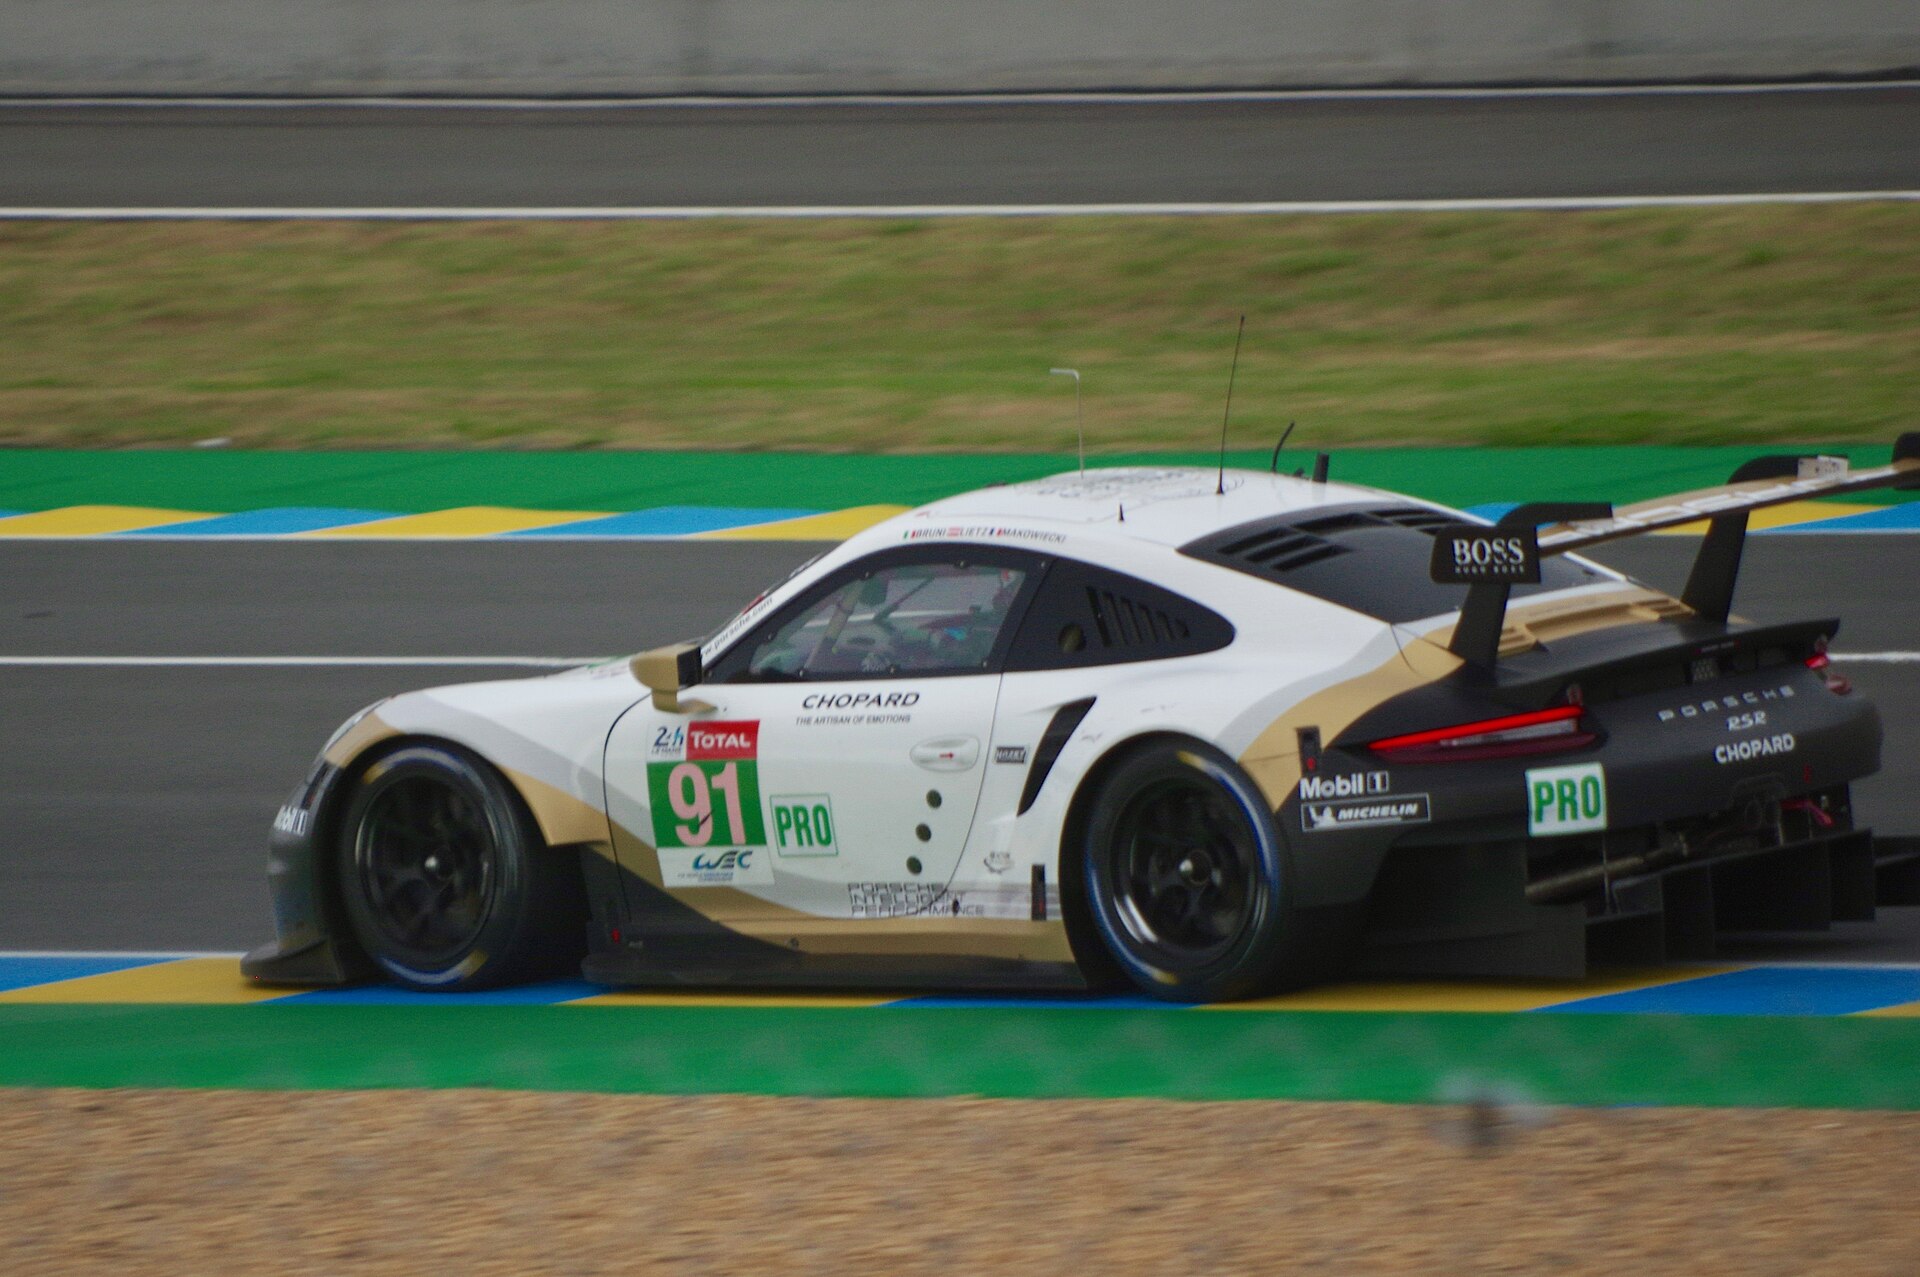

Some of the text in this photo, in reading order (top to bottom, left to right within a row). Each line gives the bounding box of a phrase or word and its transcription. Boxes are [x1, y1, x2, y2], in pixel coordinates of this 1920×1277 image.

[916, 527, 1067, 544] BRUNI LIETZ MAKOWIECKI
[1452, 538, 1524, 565] BOSS
[802, 691, 920, 709] CHOPARD
[796, 714, 911, 726] THE ARTISAN OF EMOTIONS
[1727, 710, 1767, 731] RSR
[690, 731, 751, 749] TOTAL
[1715, 733, 1796, 764] CHOPARD
[1299, 772, 1364, 799] Mobil
[668, 762, 747, 846] 91
[1533, 775, 1601, 824] PRO
[1338, 803, 1418, 820] MICHELIN
[774, 804, 832, 847] PRO
[693, 850, 753, 870] WEC
[847, 883, 944, 894] PORSCHE
